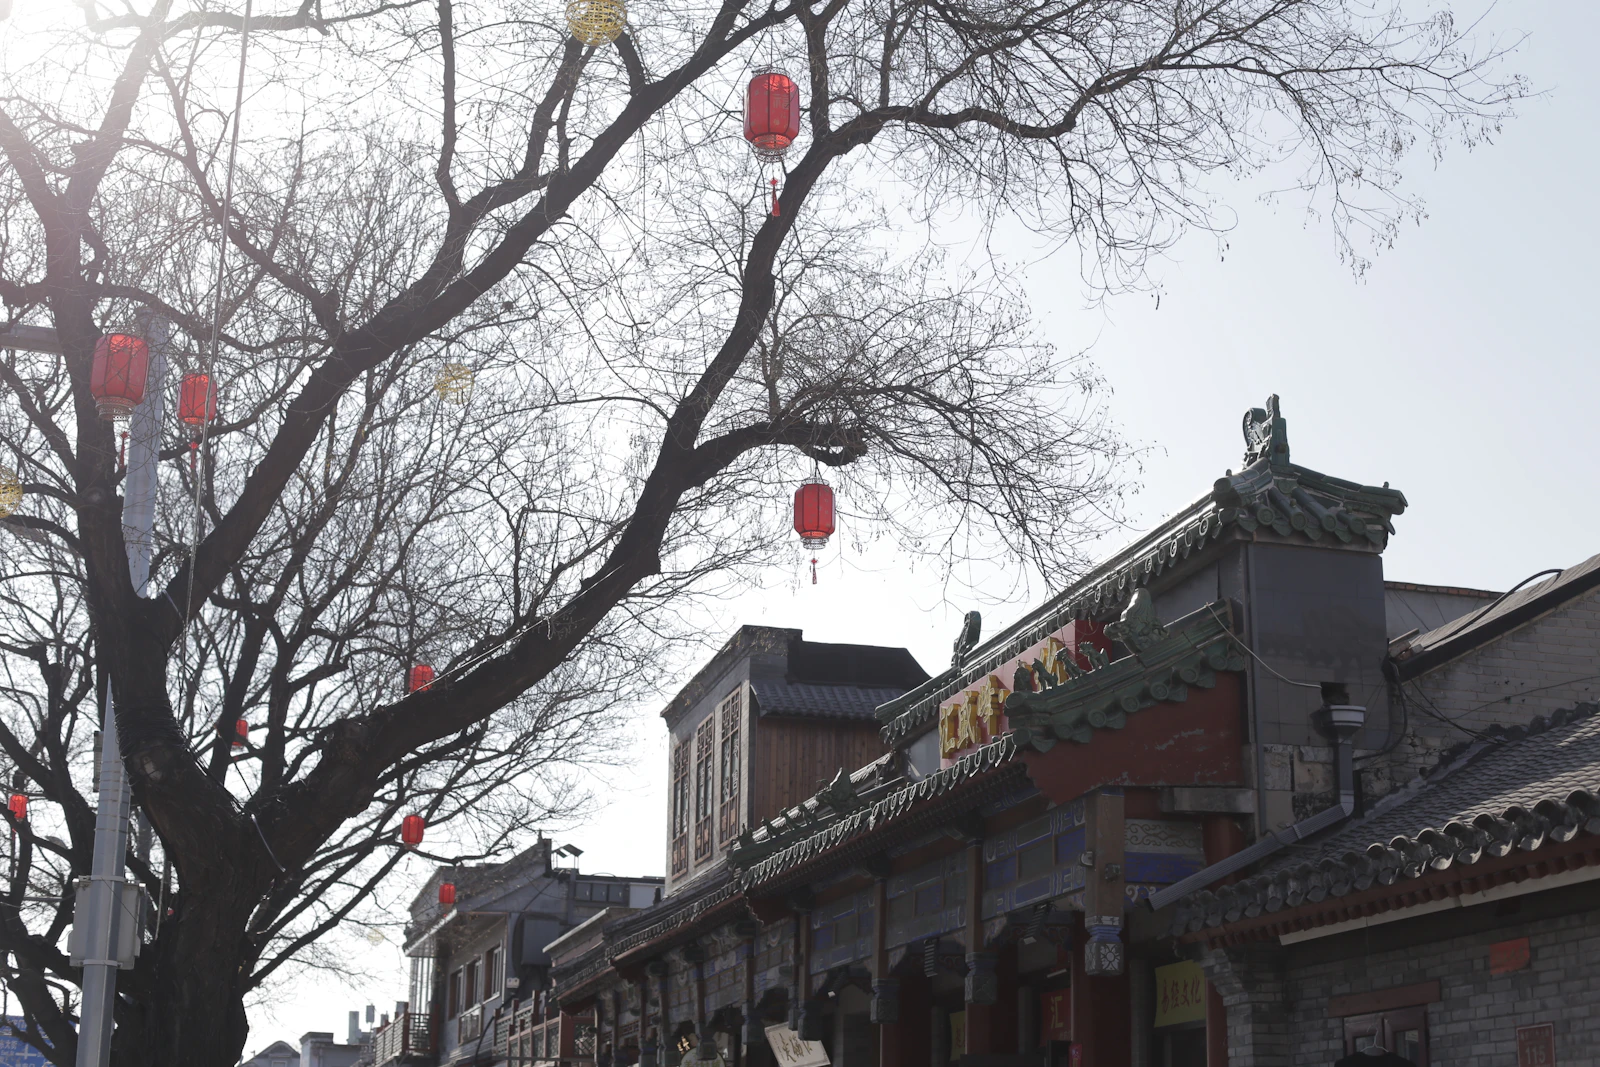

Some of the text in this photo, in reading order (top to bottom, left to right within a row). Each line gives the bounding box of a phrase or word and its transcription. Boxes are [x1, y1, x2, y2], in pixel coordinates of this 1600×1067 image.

[773, 93, 789, 110] 福
[1050, 995, 1064, 1030] 汇
[1525, 1045, 1546, 1064] 115
